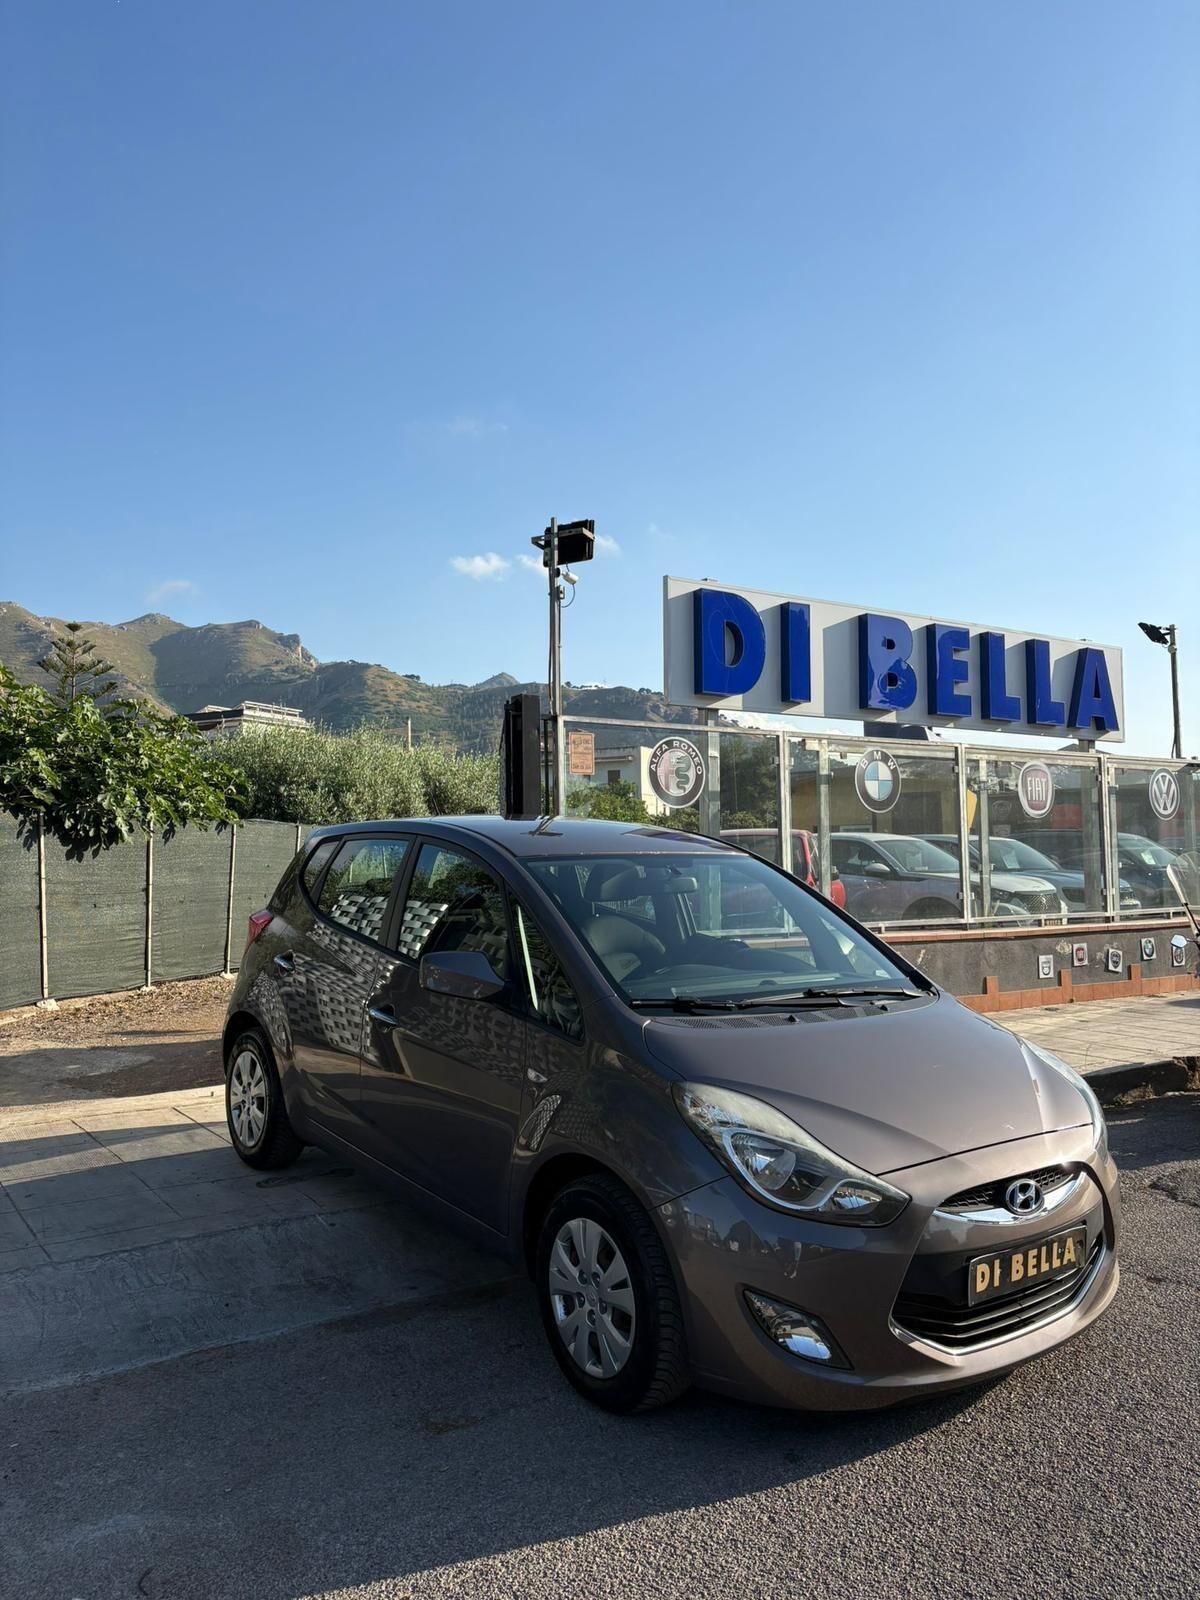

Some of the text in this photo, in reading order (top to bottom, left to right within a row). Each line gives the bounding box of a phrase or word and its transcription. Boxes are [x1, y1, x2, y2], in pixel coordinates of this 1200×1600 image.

[693, 588, 1119, 731] DI BELLA
[650, 740, 703, 775] ALFA ROMEO
[860, 750, 896, 770] BMW
[1027, 777, 1047, 801] FIAT
[975, 1237, 1076, 1293] DI BELLA
